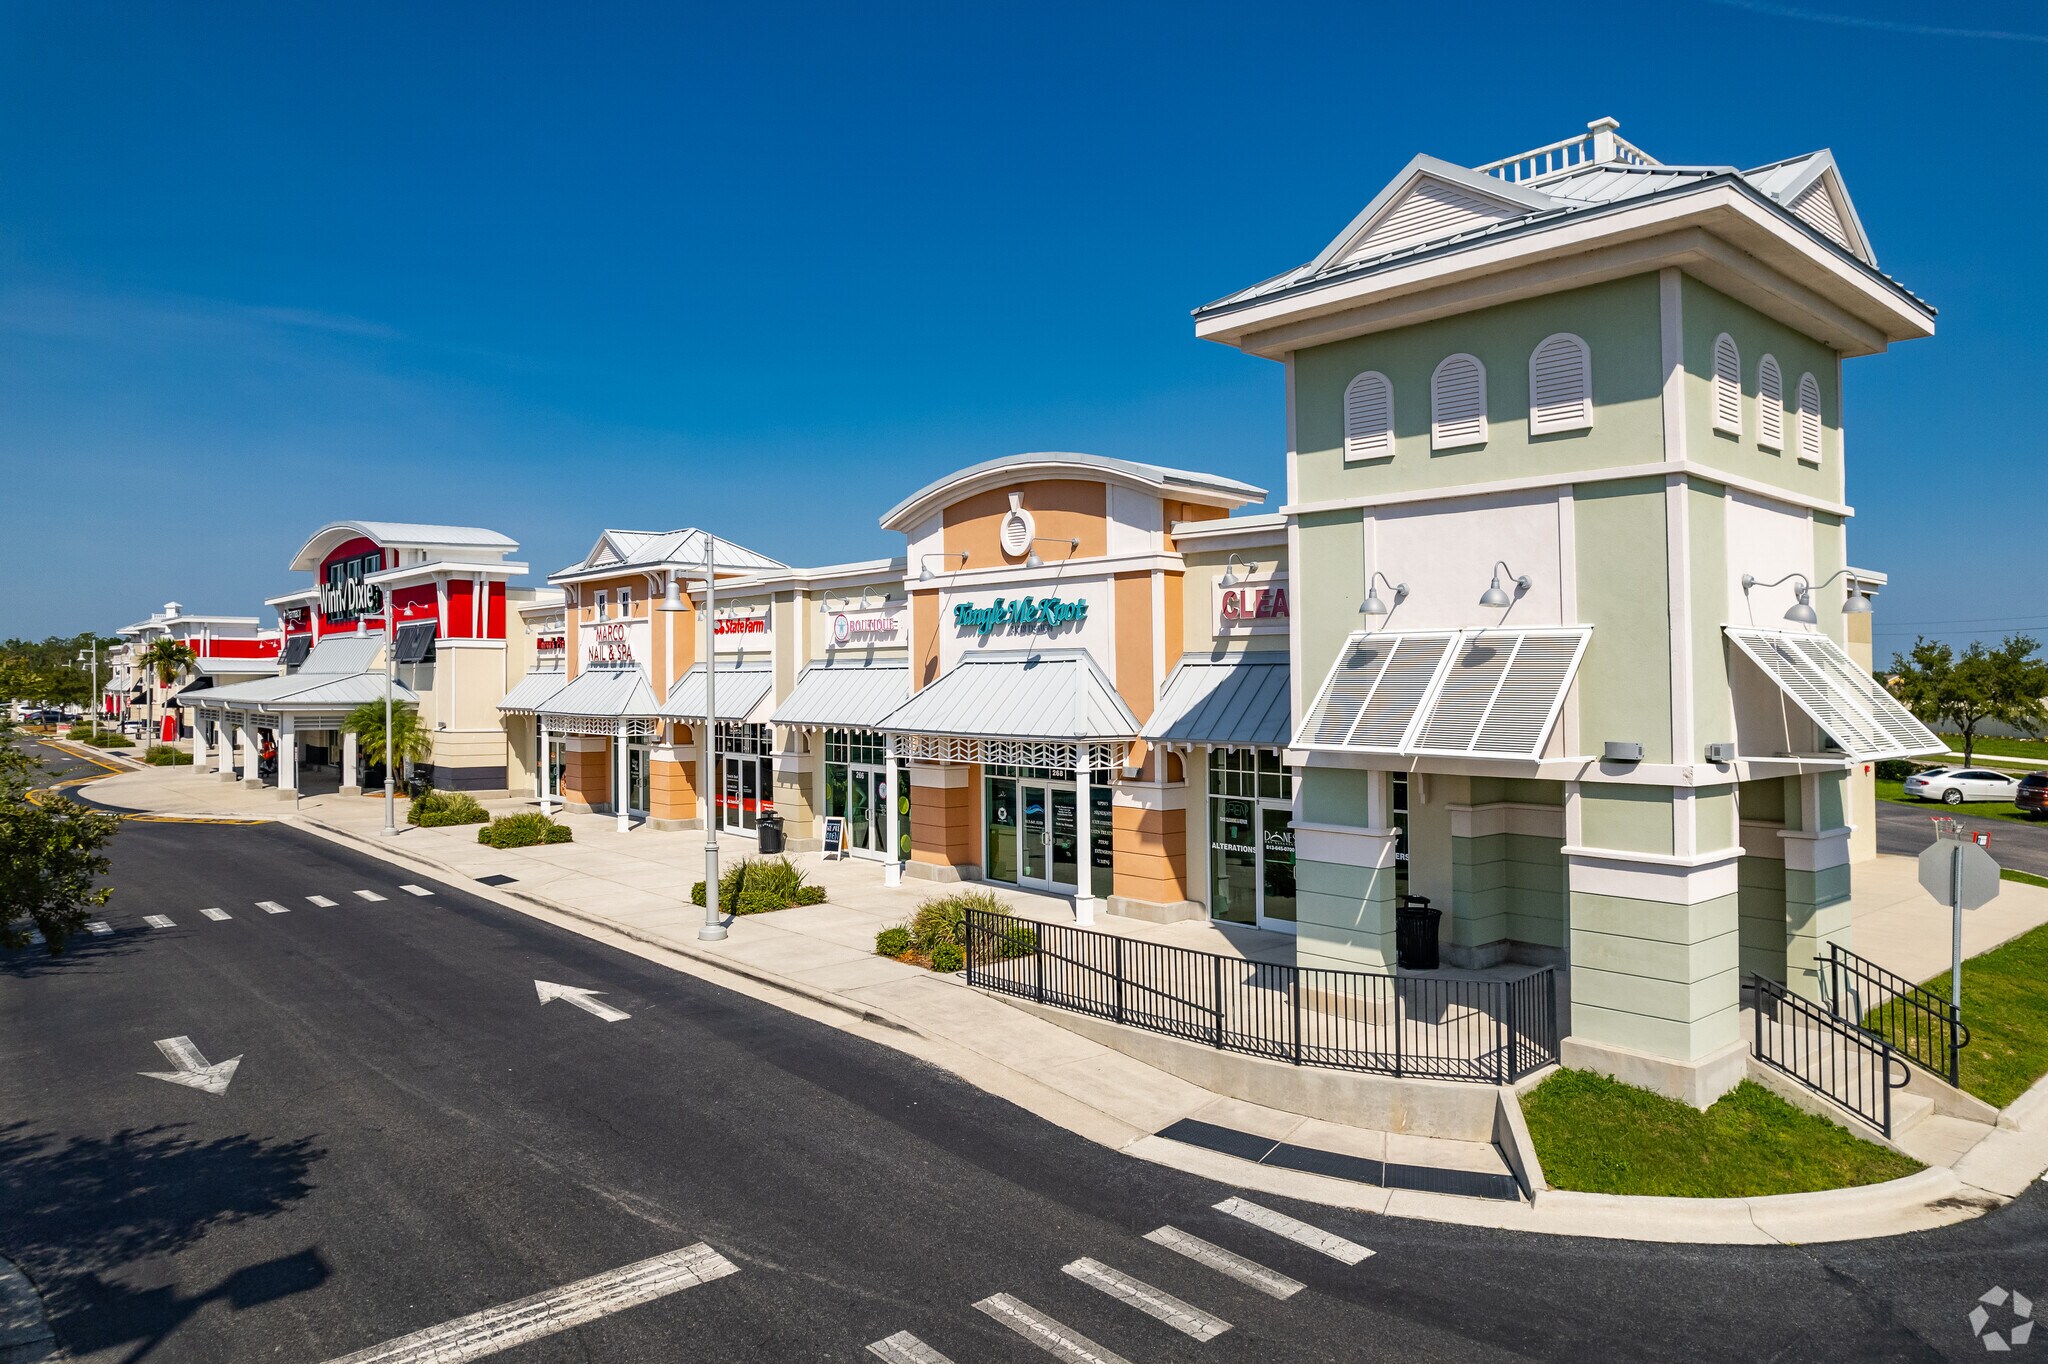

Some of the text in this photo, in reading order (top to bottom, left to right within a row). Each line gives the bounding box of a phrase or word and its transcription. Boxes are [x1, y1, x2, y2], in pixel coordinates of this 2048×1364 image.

[320, 576, 374, 614] Winn Dixie
[1222, 588, 1290, 620] CLEA
[953, 595, 1090, 635] Tangle Me Knot
[596, 624, 625, 642] MARCO
[725, 617, 764, 634] State Farm
[588, 643, 633, 661] NAIL & SPA
[1211, 841, 1257, 854] ALTERATIONS
